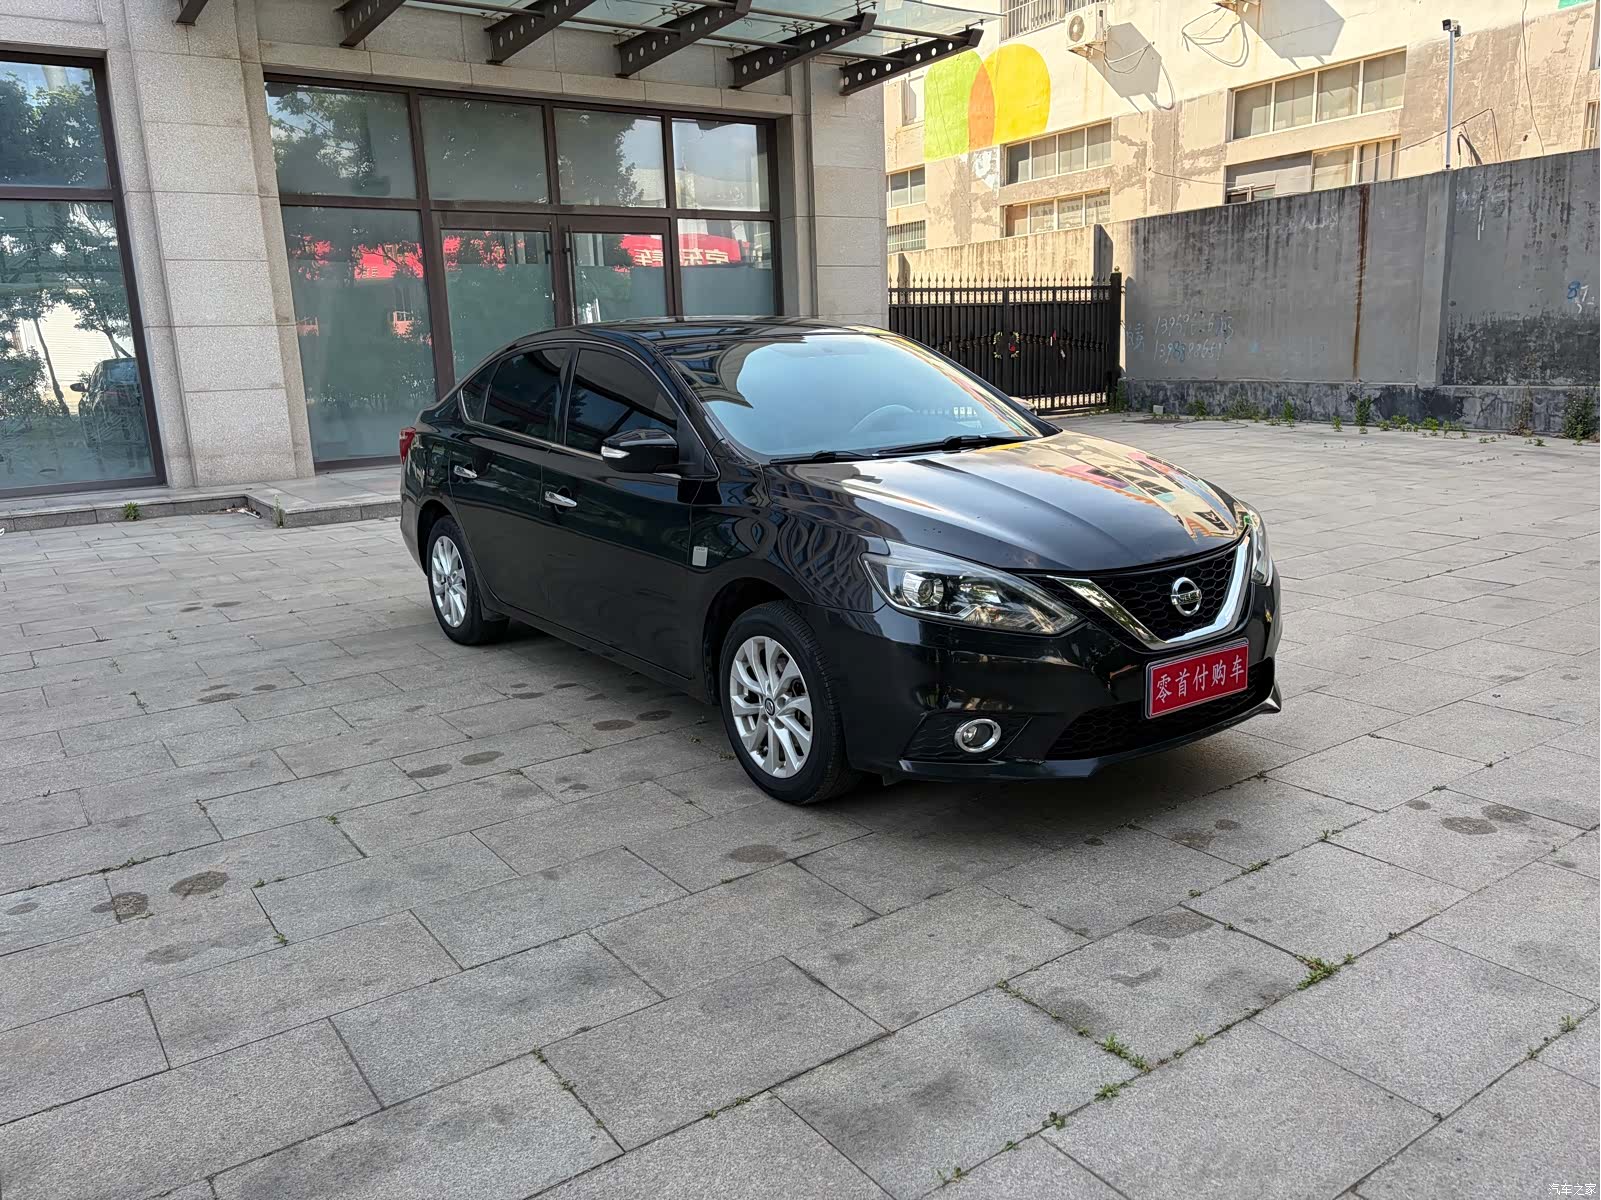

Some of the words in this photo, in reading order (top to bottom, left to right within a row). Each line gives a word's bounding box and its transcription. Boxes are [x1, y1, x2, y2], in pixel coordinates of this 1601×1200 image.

[1155, 654, 1245, 704] 零首付购车
